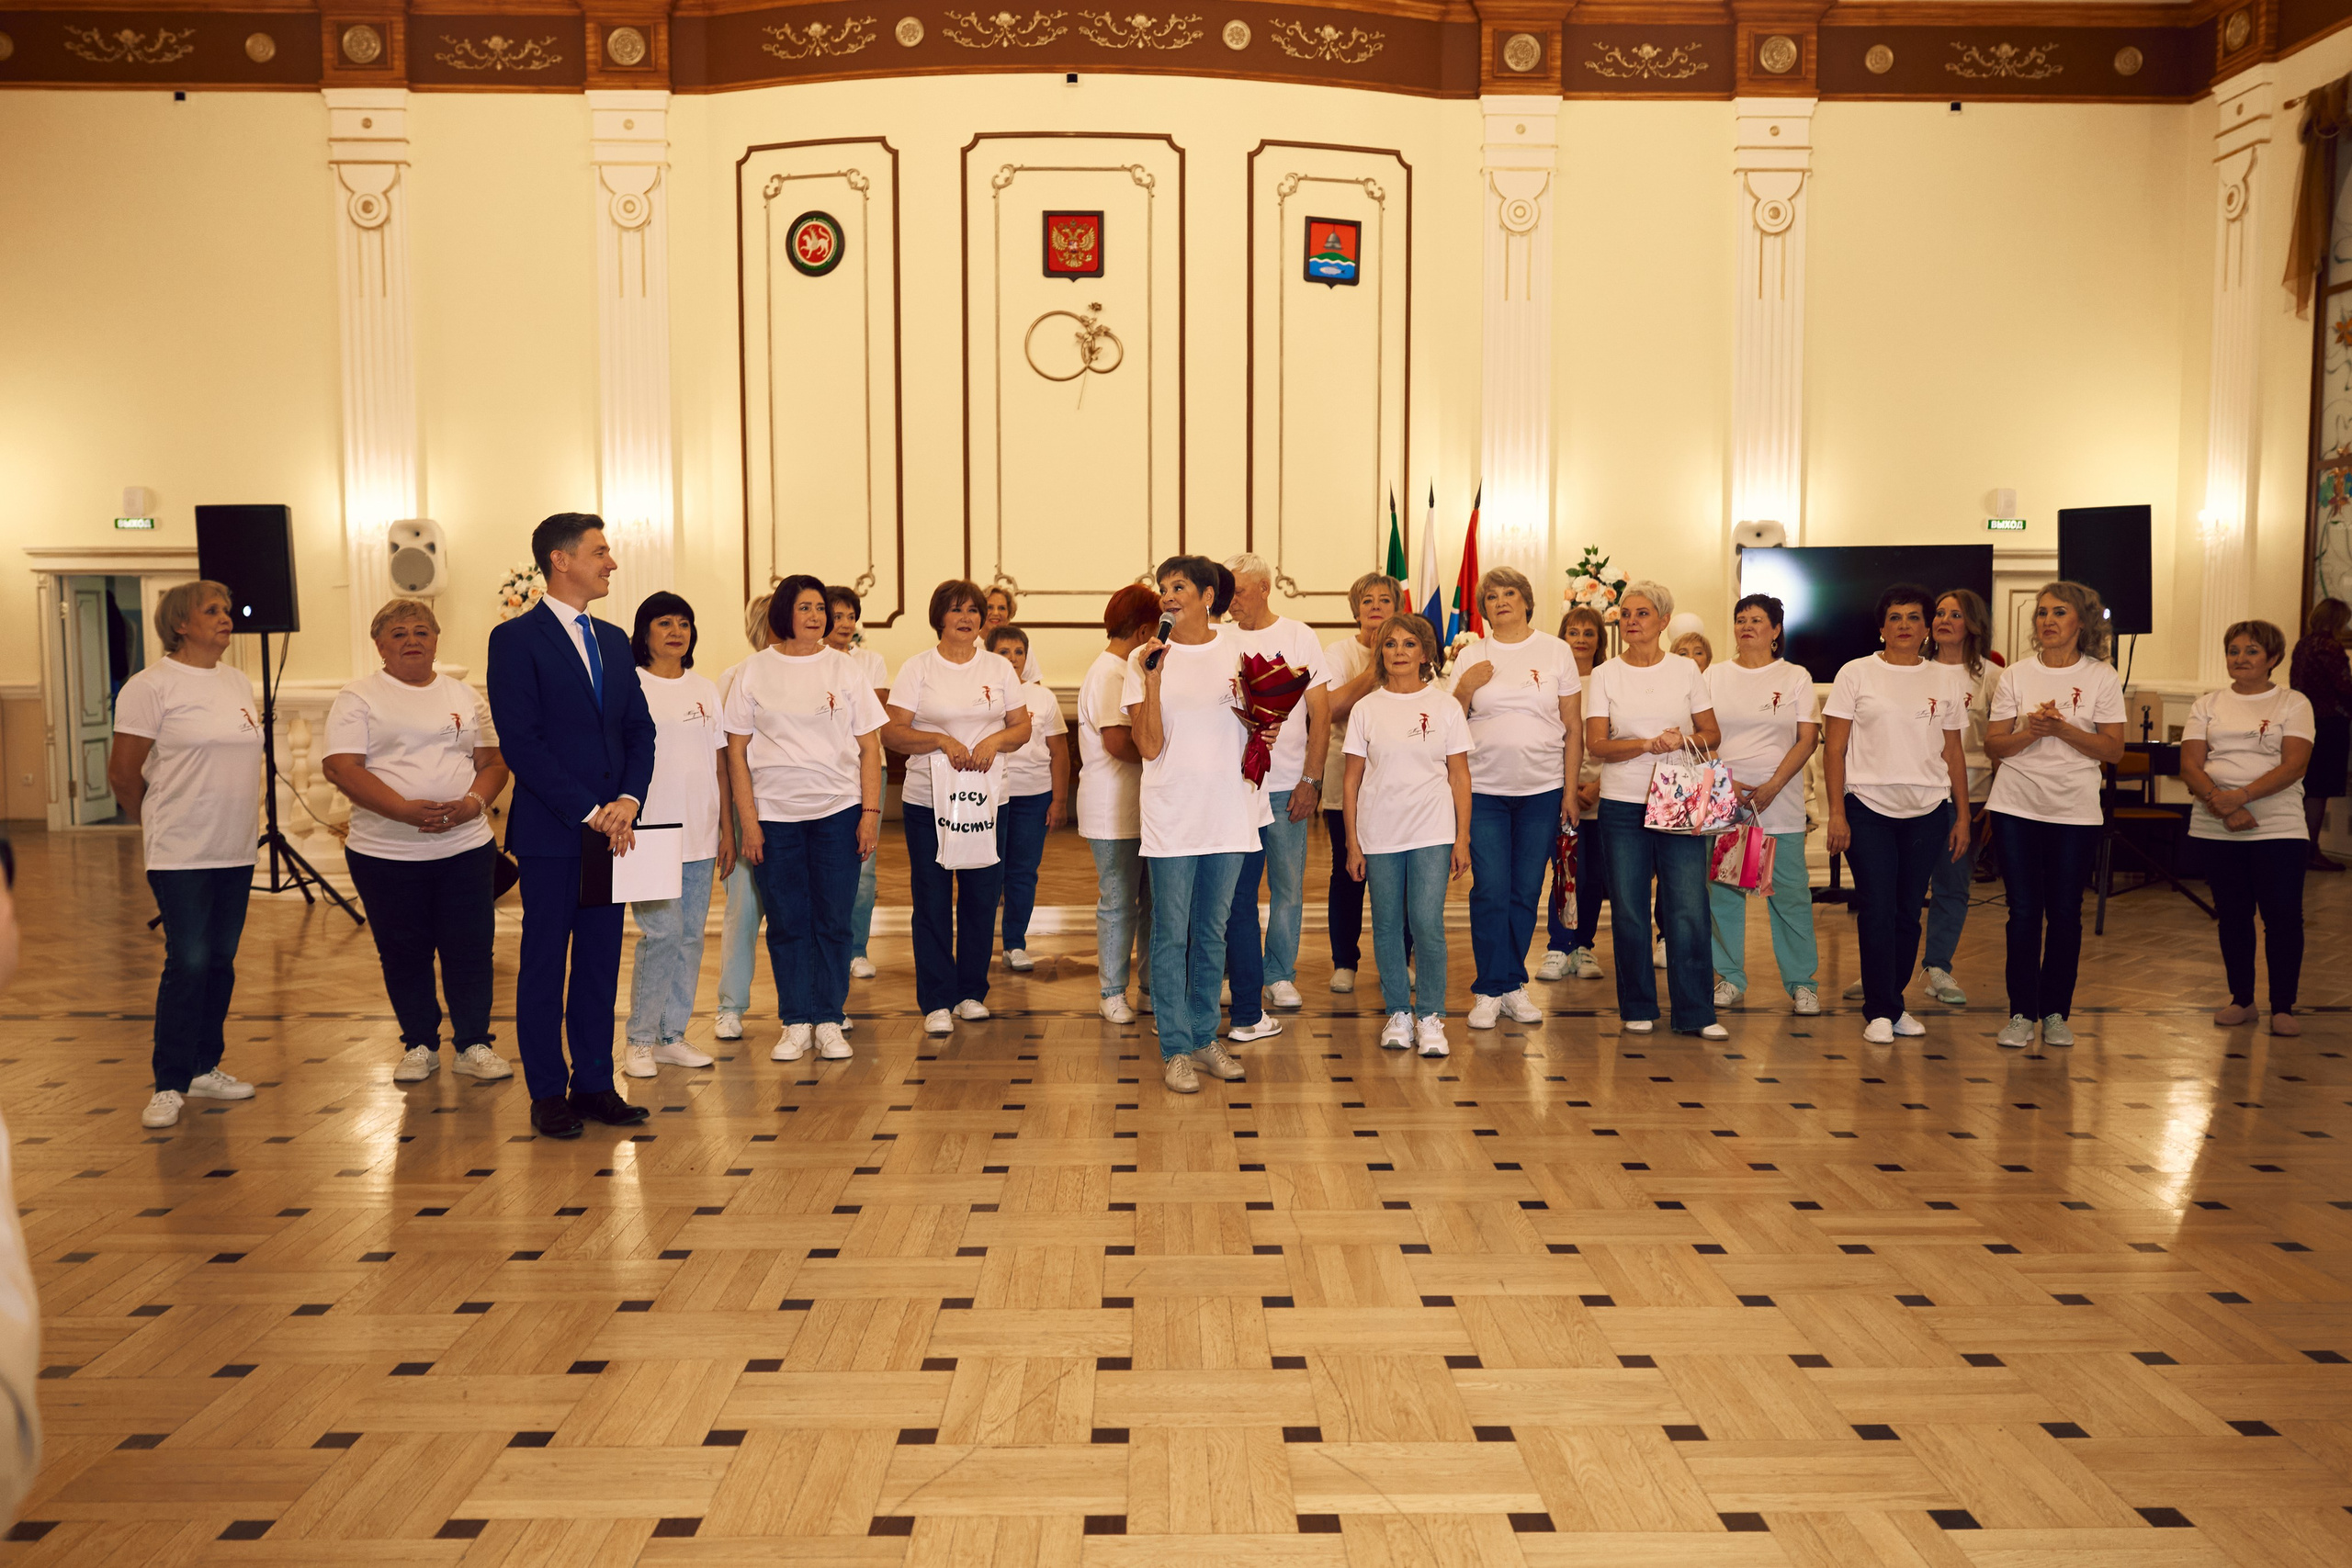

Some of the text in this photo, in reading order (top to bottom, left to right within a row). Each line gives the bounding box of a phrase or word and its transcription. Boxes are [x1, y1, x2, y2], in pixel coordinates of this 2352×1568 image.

[118, 518, 152, 528] ВЫХОД
[1991, 520, 2024, 529] ВЫХОД
[949, 791, 988, 807] несу
